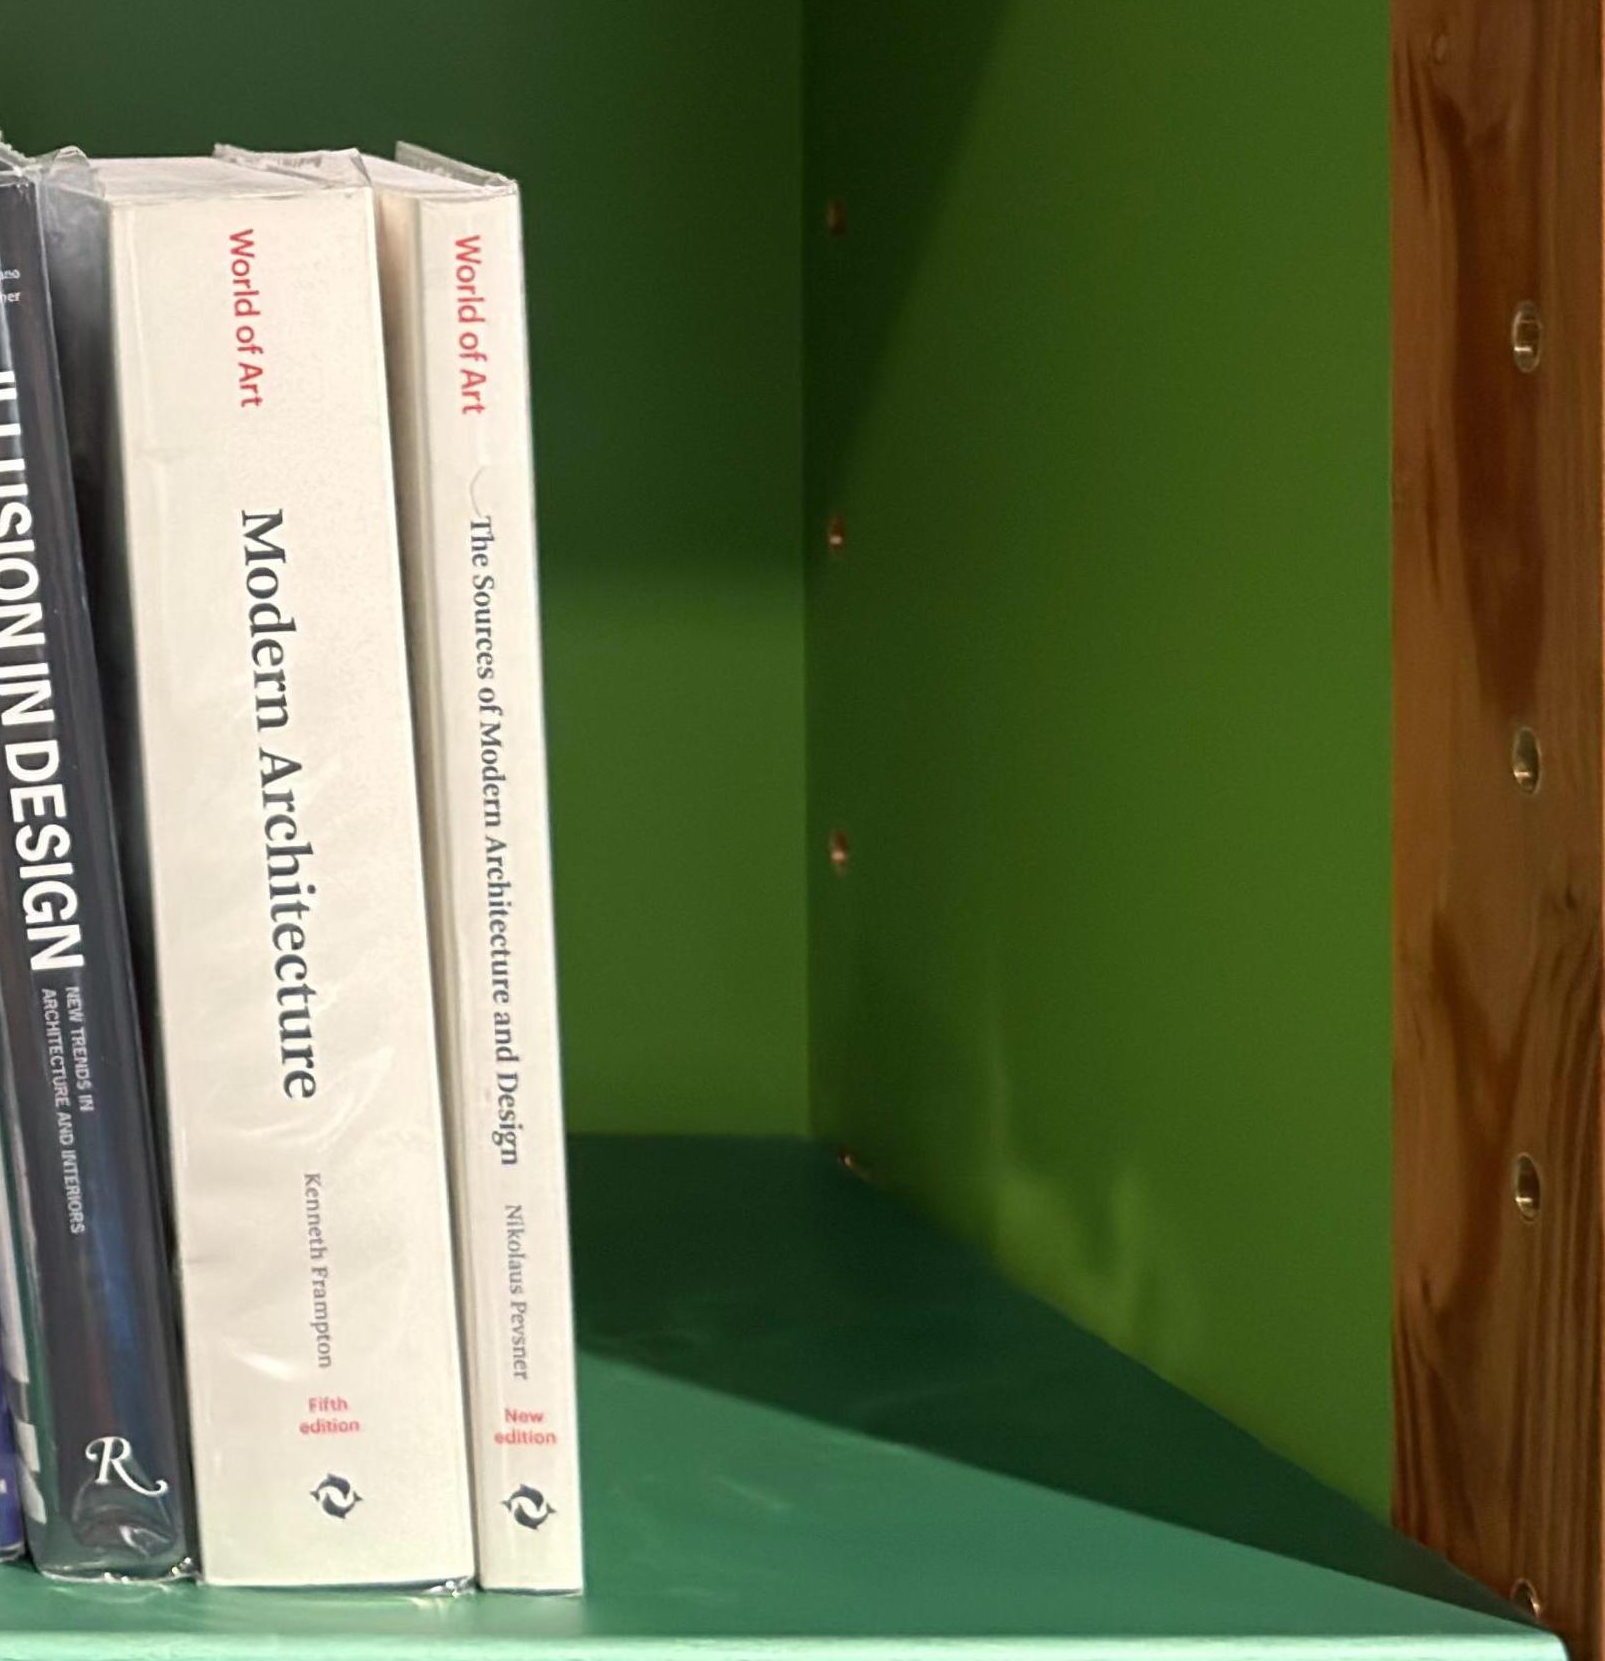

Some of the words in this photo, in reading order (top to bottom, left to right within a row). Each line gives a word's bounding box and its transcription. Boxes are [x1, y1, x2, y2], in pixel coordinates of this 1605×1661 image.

[229, 228, 257, 318] World
[455, 235, 484, 324] World
[235, 323, 263, 357] of
[458, 329, 489, 364] of
[239, 362, 264, 409] Art
[459, 368, 486, 415] Art
[470, 516, 495, 567] The
[242, 509, 296, 733] Modern
[472, 574, 495, 680] Sources
[478, 687, 503, 716] of
[480, 721, 506, 827] Modern
[4, 740, 85, 971] DESIGN
[259, 747, 317, 1100] Architecture
[485, 837, 512, 1004] Architecture
[66, 986, 83, 1020] NEW
[494, 1010, 519, 1063] and
[42, 988, 71, 1108] ARCHITECTURE
[71, 1026, 92, 1091] TRENDS
[57, 1112, 75, 1145] AND
[79, 1095, 94, 1112] IN
[491, 1073, 523, 1166] Design
[61, 1150, 85, 1235] INTERIORS
[303, 1173, 328, 1260] Kenneth
[504, 1204, 527, 1295] Nikolaus
[310, 1266, 332, 1368] Frampton
[510, 1300, 529, 1381] Pevsner
[299, 1419, 360, 1435] edition
[308, 1397, 348, 1413] Fifth
[494, 1429, 557, 1446] edition
[505, 1408, 544, 1423] New
